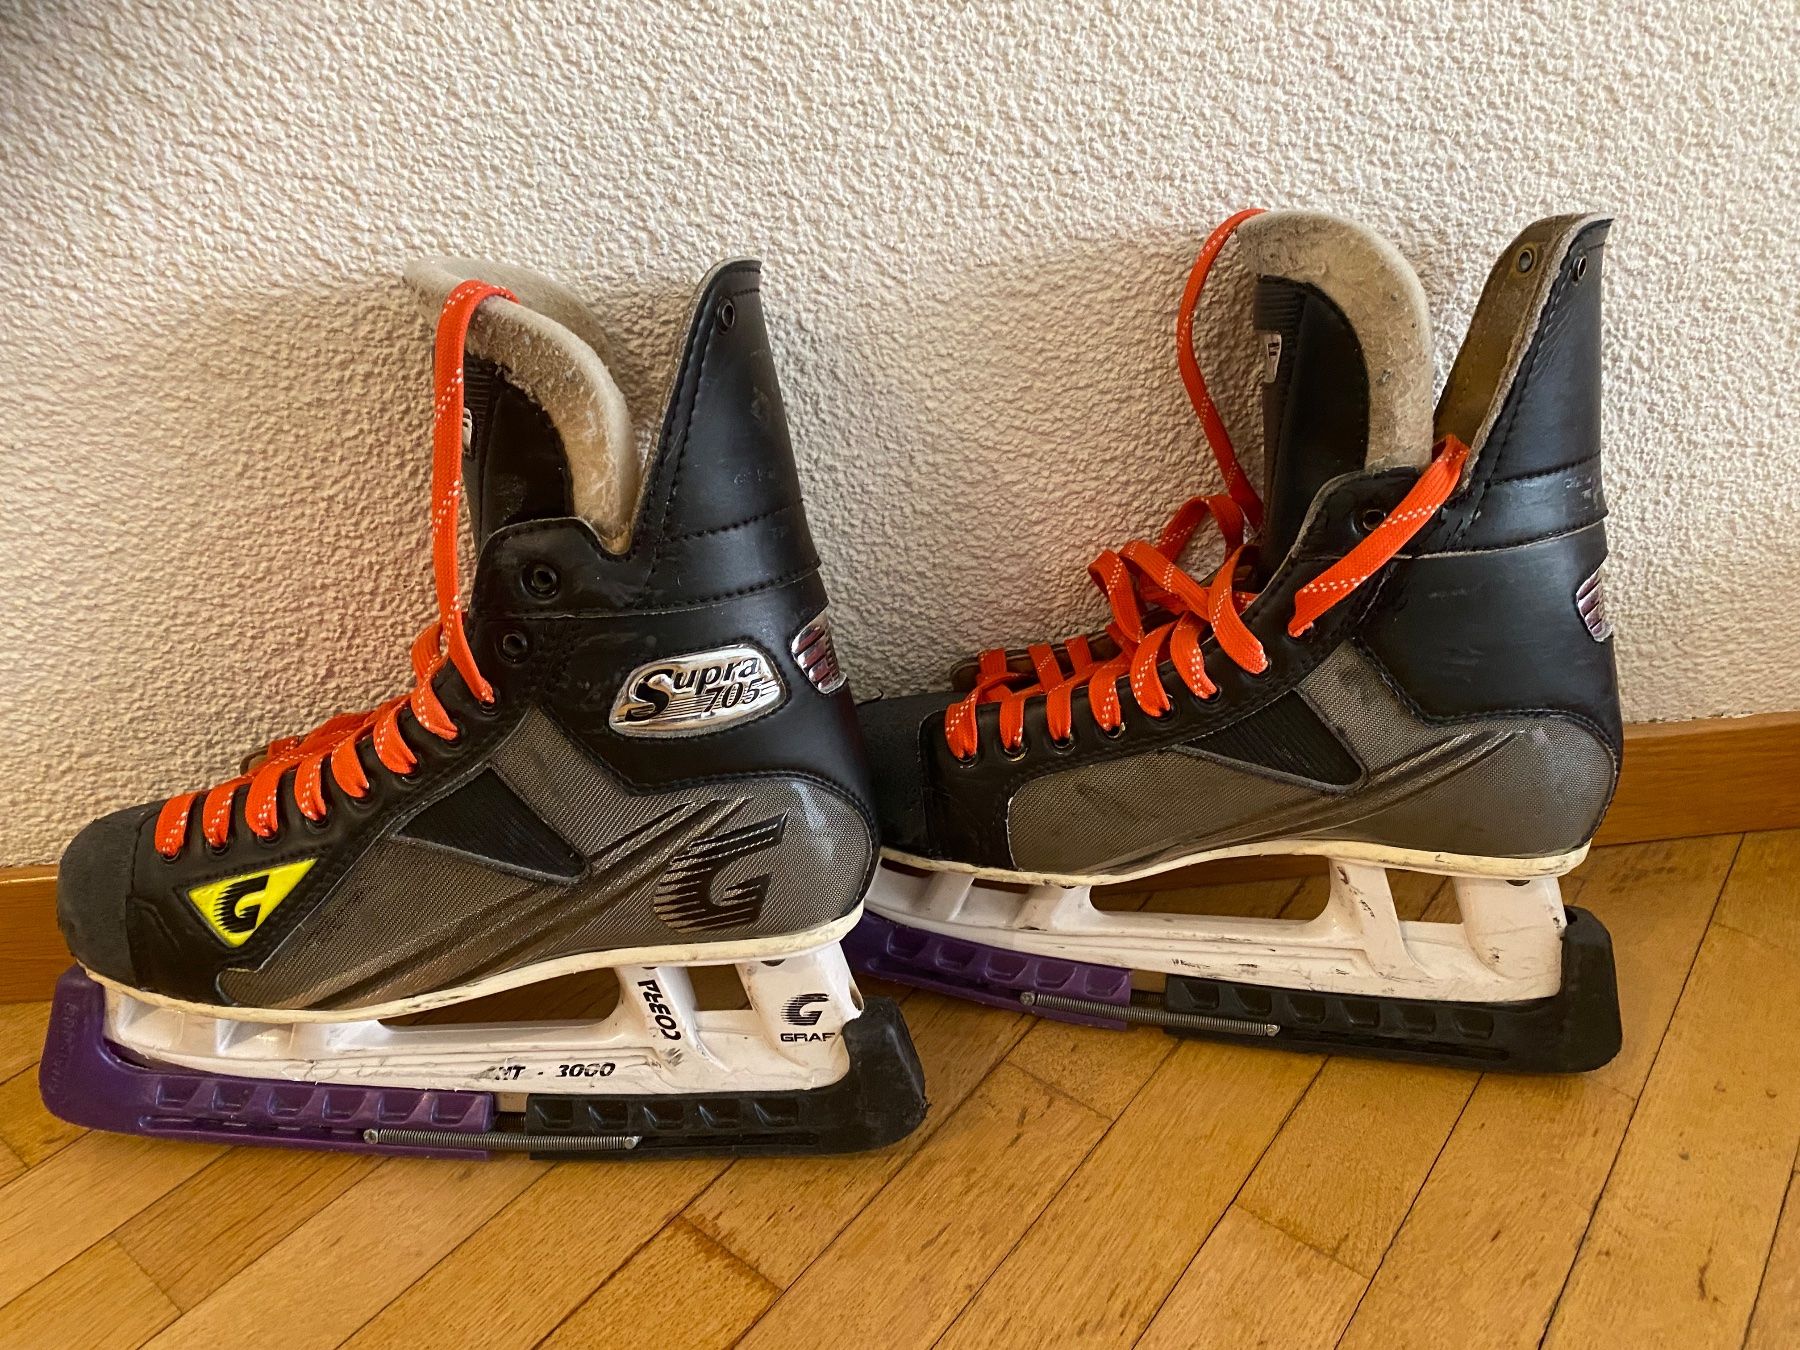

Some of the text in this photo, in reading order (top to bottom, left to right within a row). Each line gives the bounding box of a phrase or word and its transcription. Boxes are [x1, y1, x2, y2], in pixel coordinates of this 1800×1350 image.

[625, 656, 761, 722] Supra
[702, 677, 765, 713] 705
[213, 874, 270, 934] G
[636, 979, 682, 1041] COBRA
[780, 992, 829, 1027] G
[780, 1032, 836, 1042] GRAF
[555, 1062, 617, 1078] 3000
